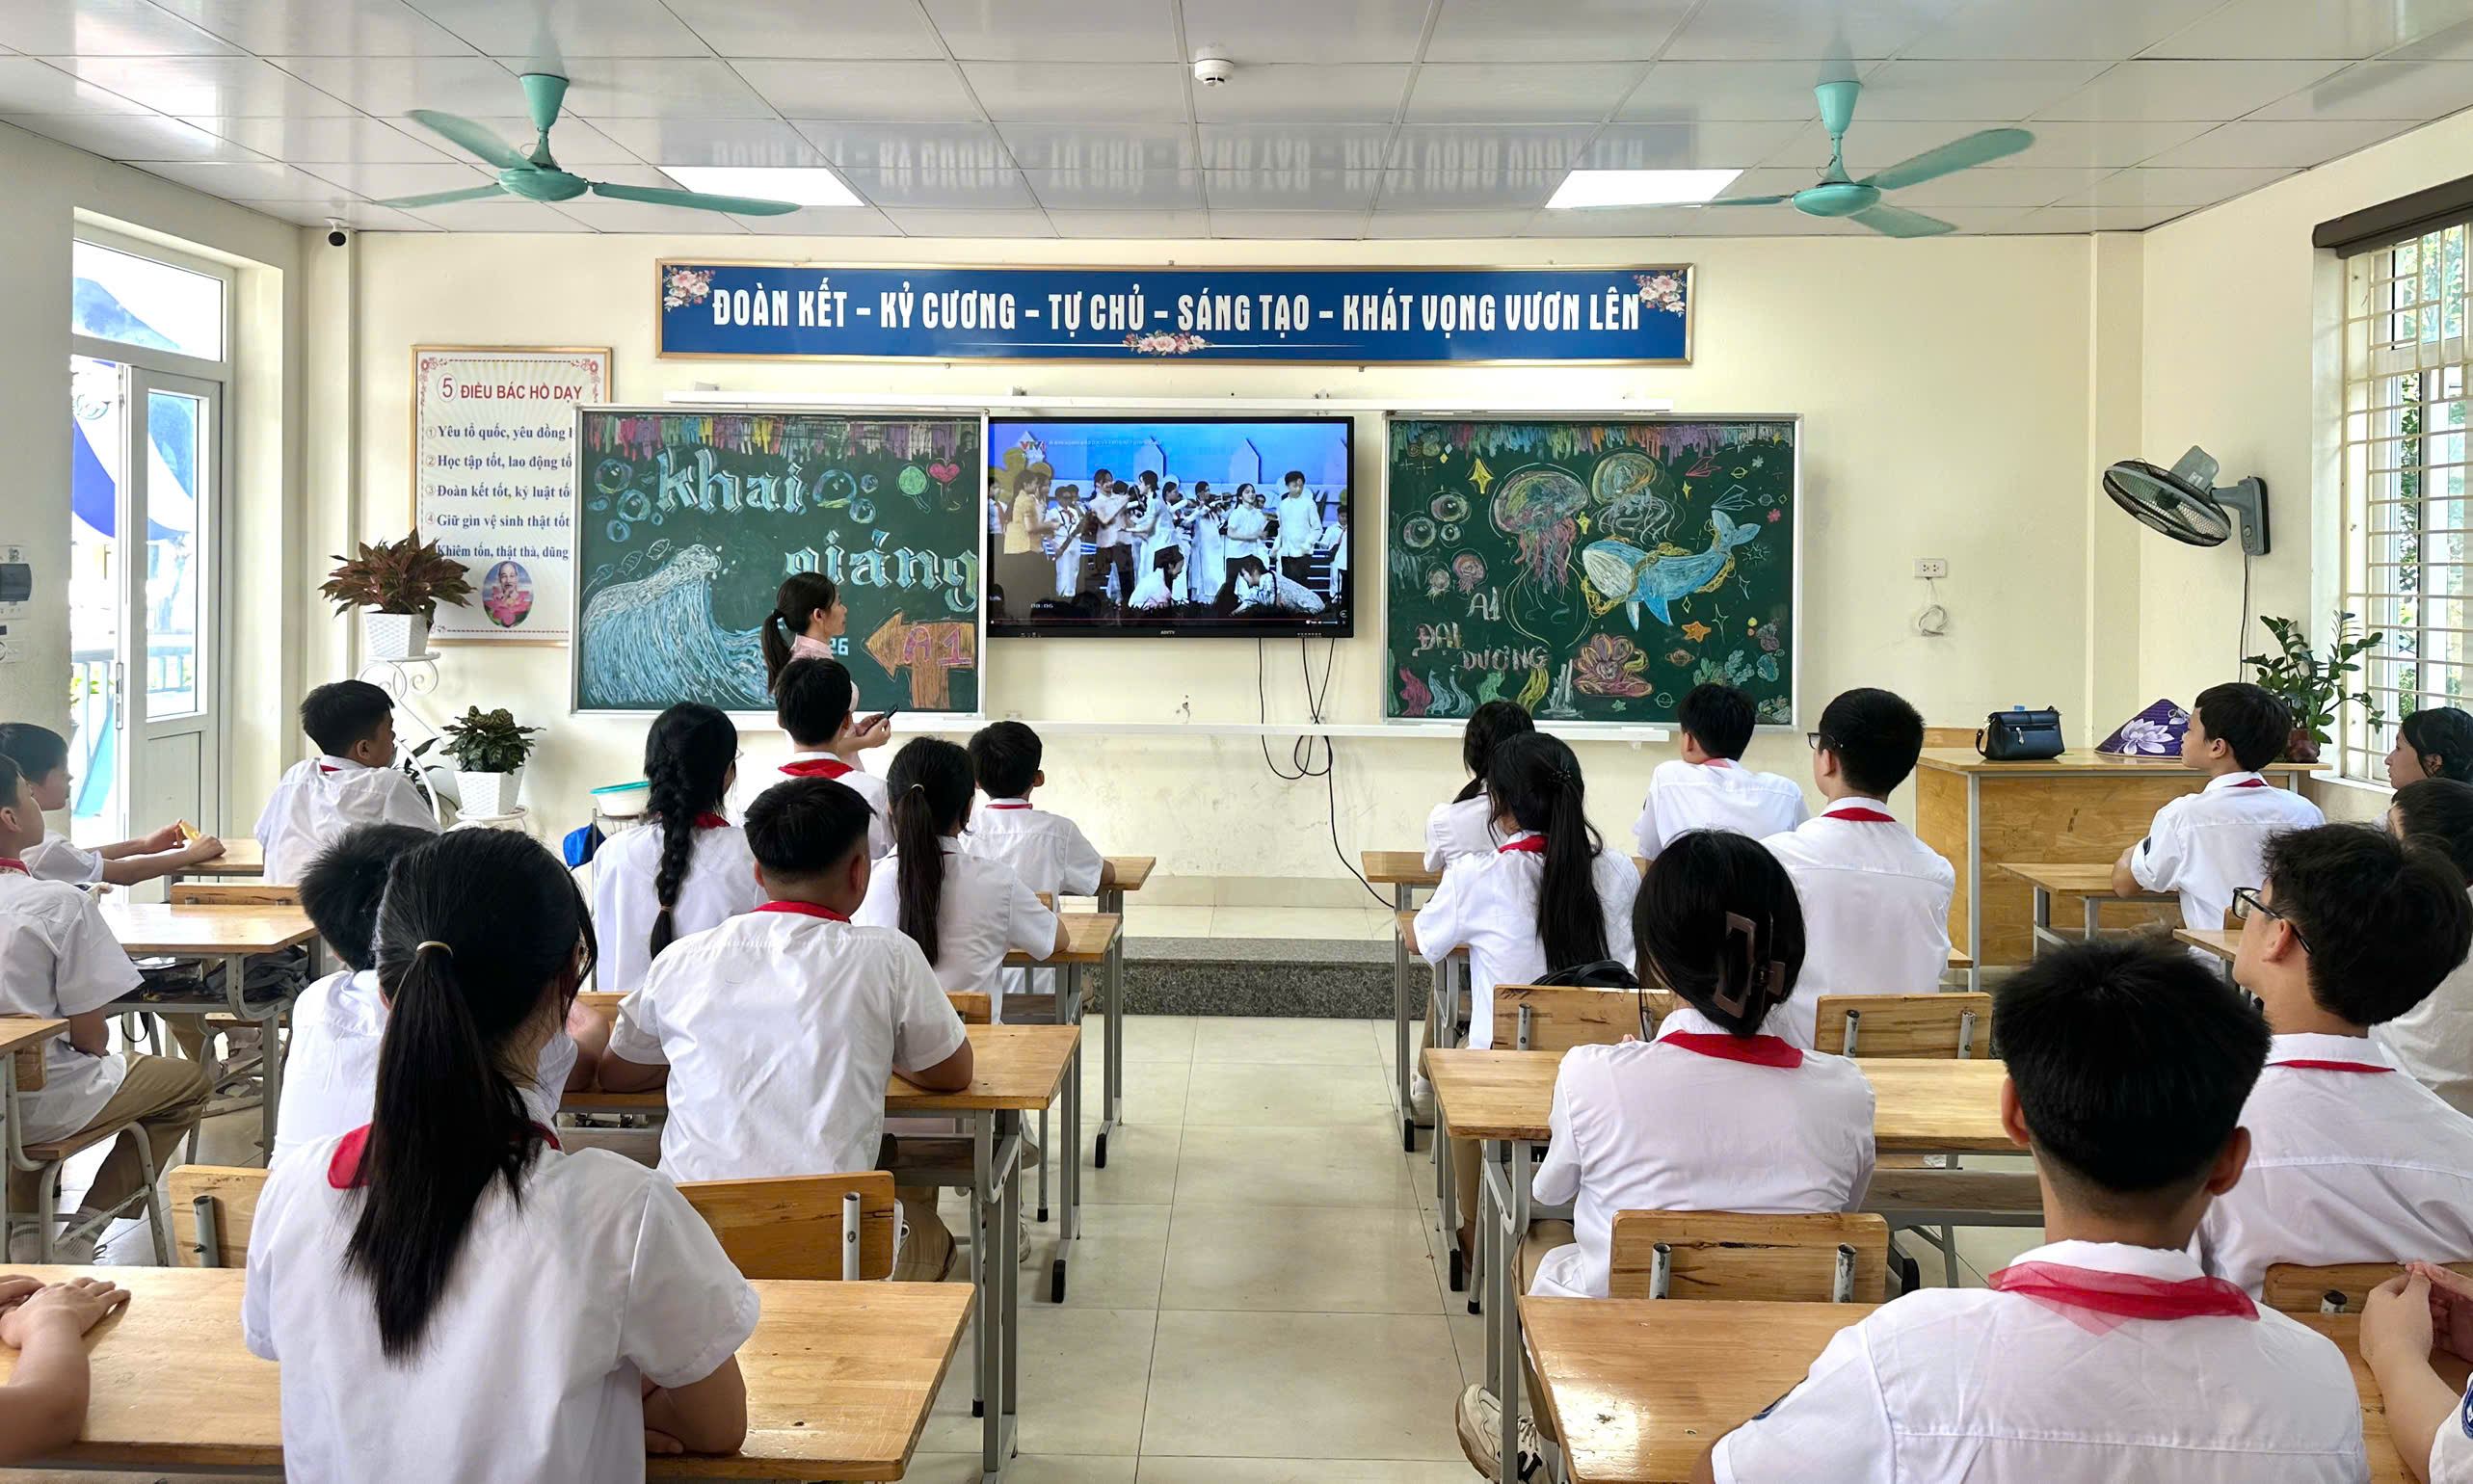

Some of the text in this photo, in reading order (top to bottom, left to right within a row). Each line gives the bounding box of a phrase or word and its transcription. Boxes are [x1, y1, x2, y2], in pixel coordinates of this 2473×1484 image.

[711, 282, 788, 327] ĐOÀN
[798, 277, 848, 328] KẾT
[880, 280, 915, 329] KỶ
[922, 289, 1016, 330] CƯƠNG
[1048, 291, 1083, 338] TỰ
[1090, 283, 1145, 331] CHỦ
[1178, 287, 1251, 331] SÁNG
[1259, 294, 1310, 339] TẠO
[1343, 287, 1414, 331] KHÁT
[1422, 294, 1496, 339] VỌNG
[1504, 291, 1580, 331] VƯƠN
[1589, 286, 1639, 331] LÊN
[442, 377, 453, 398] 5
[497, 382, 525, 399] BÁC
[554, 385, 582, 403] DẠY
[438, 425, 461, 437] Yêu
[479, 423, 510, 440] quốc,
[513, 426, 533, 440] yêu
[537, 424, 566, 440] đồng
[438, 455, 461, 469] Học
[464, 455, 483, 469] tập
[486, 452, 505, 468] tốt,
[508, 456, 525, 467] lao
[529, 456, 558, 470] động
[561, 453, 572, 468] tố
[655, 446, 808, 516] khai
[437, 485, 467, 497] Đoàn
[471, 482, 490, 497] kết
[492, 482, 512, 499] tốt,
[532, 486, 555, 500] luật
[558, 483, 572, 498] tố
[437, 514, 460, 526] Giữ
[463, 515, 480, 529] gìn
[484, 515, 497, 529] vệ
[500, 515, 524, 527] sinh
[527, 515, 550, 530] thật
[554, 512, 571, 527] tốt
[437, 542, 569, 560] Khiêm tốn, thật thà, dũng
